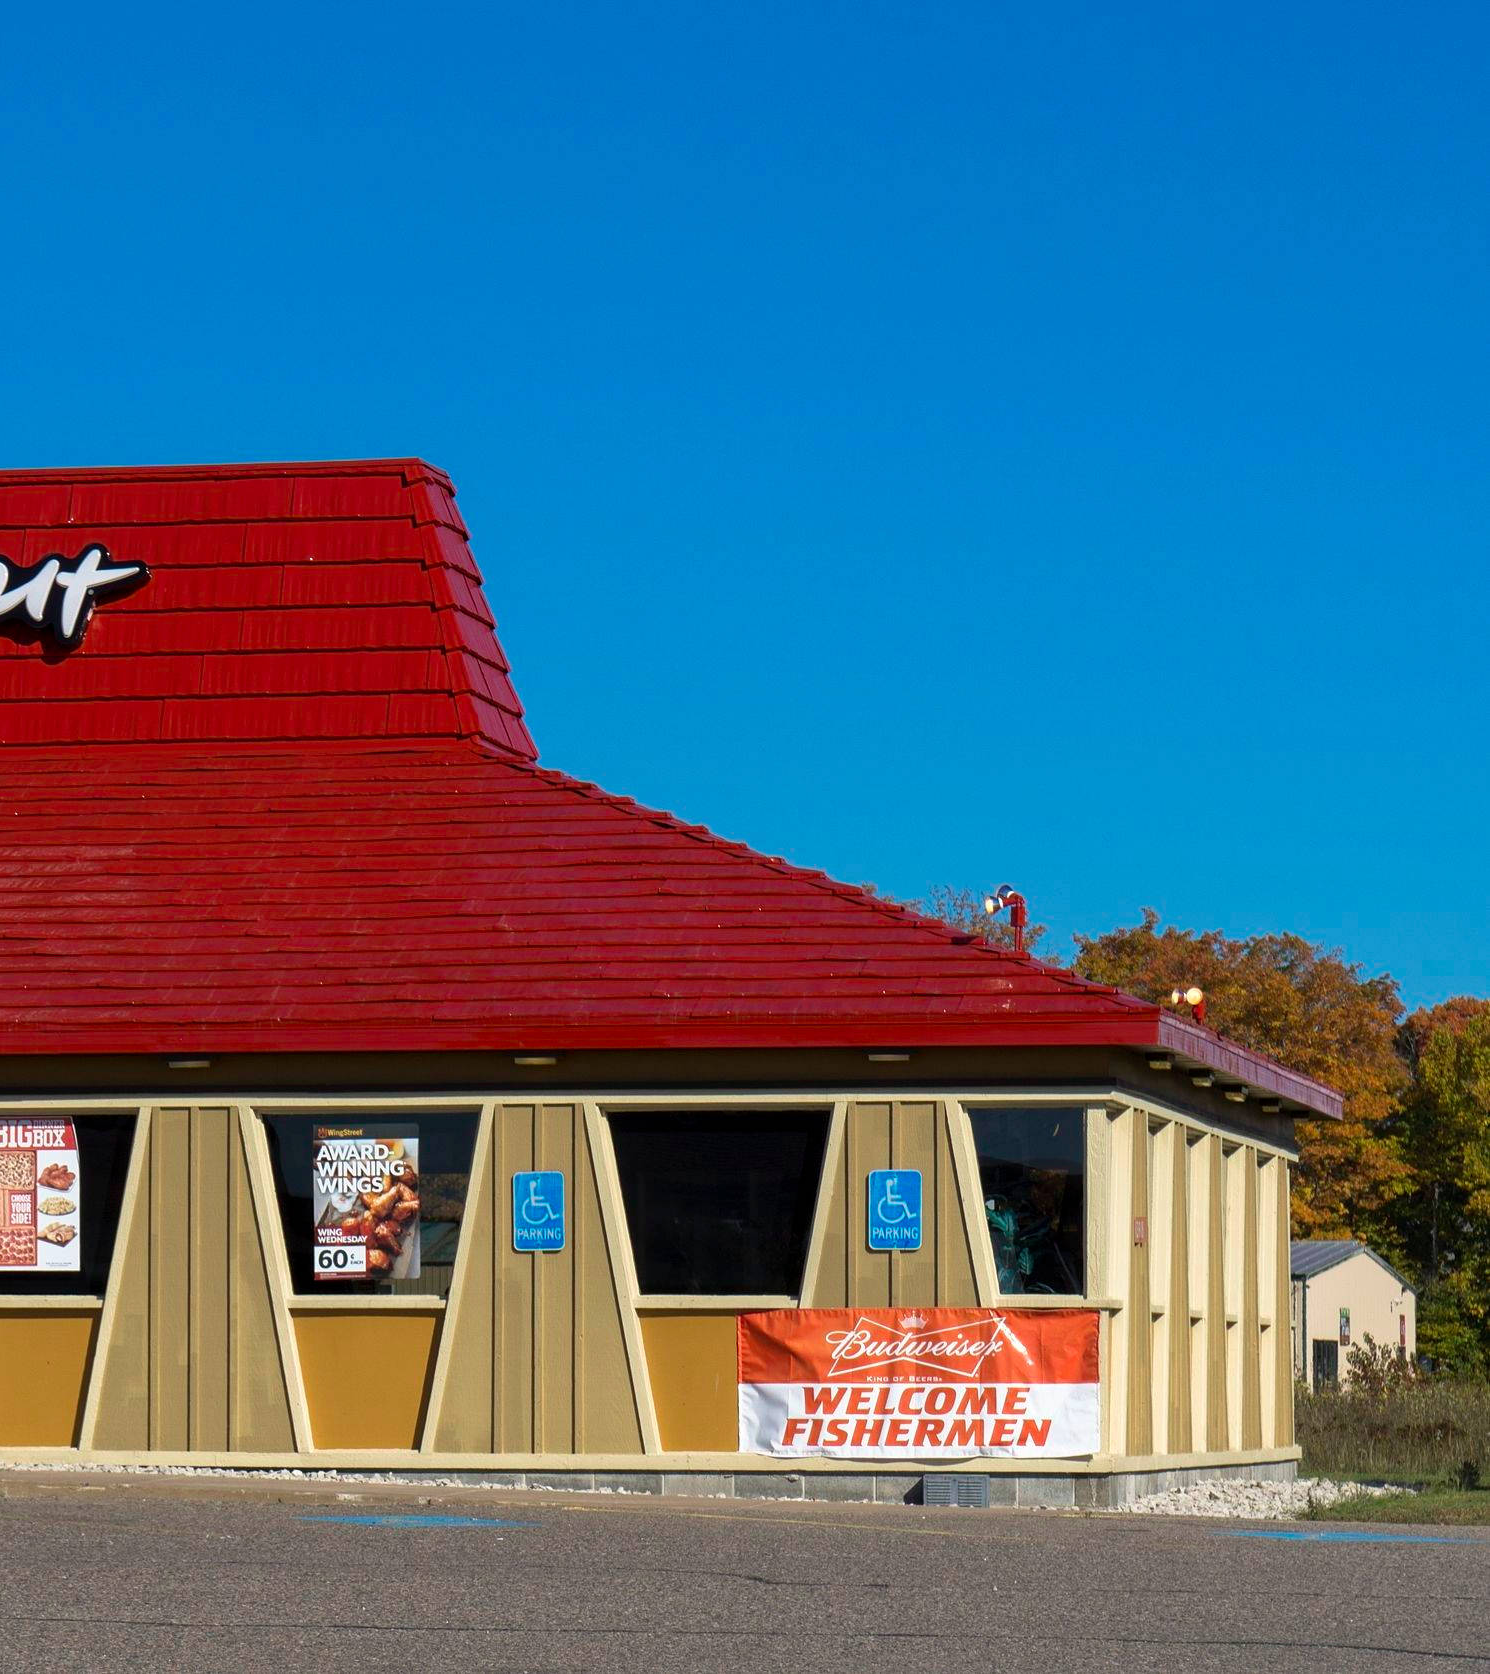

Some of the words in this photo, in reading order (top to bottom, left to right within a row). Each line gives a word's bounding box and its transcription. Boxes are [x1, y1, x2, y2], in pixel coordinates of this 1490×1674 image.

[33, 1130, 65, 1147] BOX
[328, 1128, 363, 1137] WingStreet
[317, 1144, 394, 1160] AWARD-
[317, 1177, 383, 1193] WINGS
[11, 1194, 32, 1202] CHOOSE
[11, 1202, 32, 1212] YOUR
[11, 1212, 32, 1224] SIDE!
[318, 1228, 343, 1236] WING
[517, 1228, 561, 1240] PARKING
[872, 1227, 918, 1239] PARKING
[825, 1330, 1003, 1360] Budweiser
[802, 1387, 1030, 1416] WELCOME
[781, 1418, 1052, 1447] FISHERMEN
